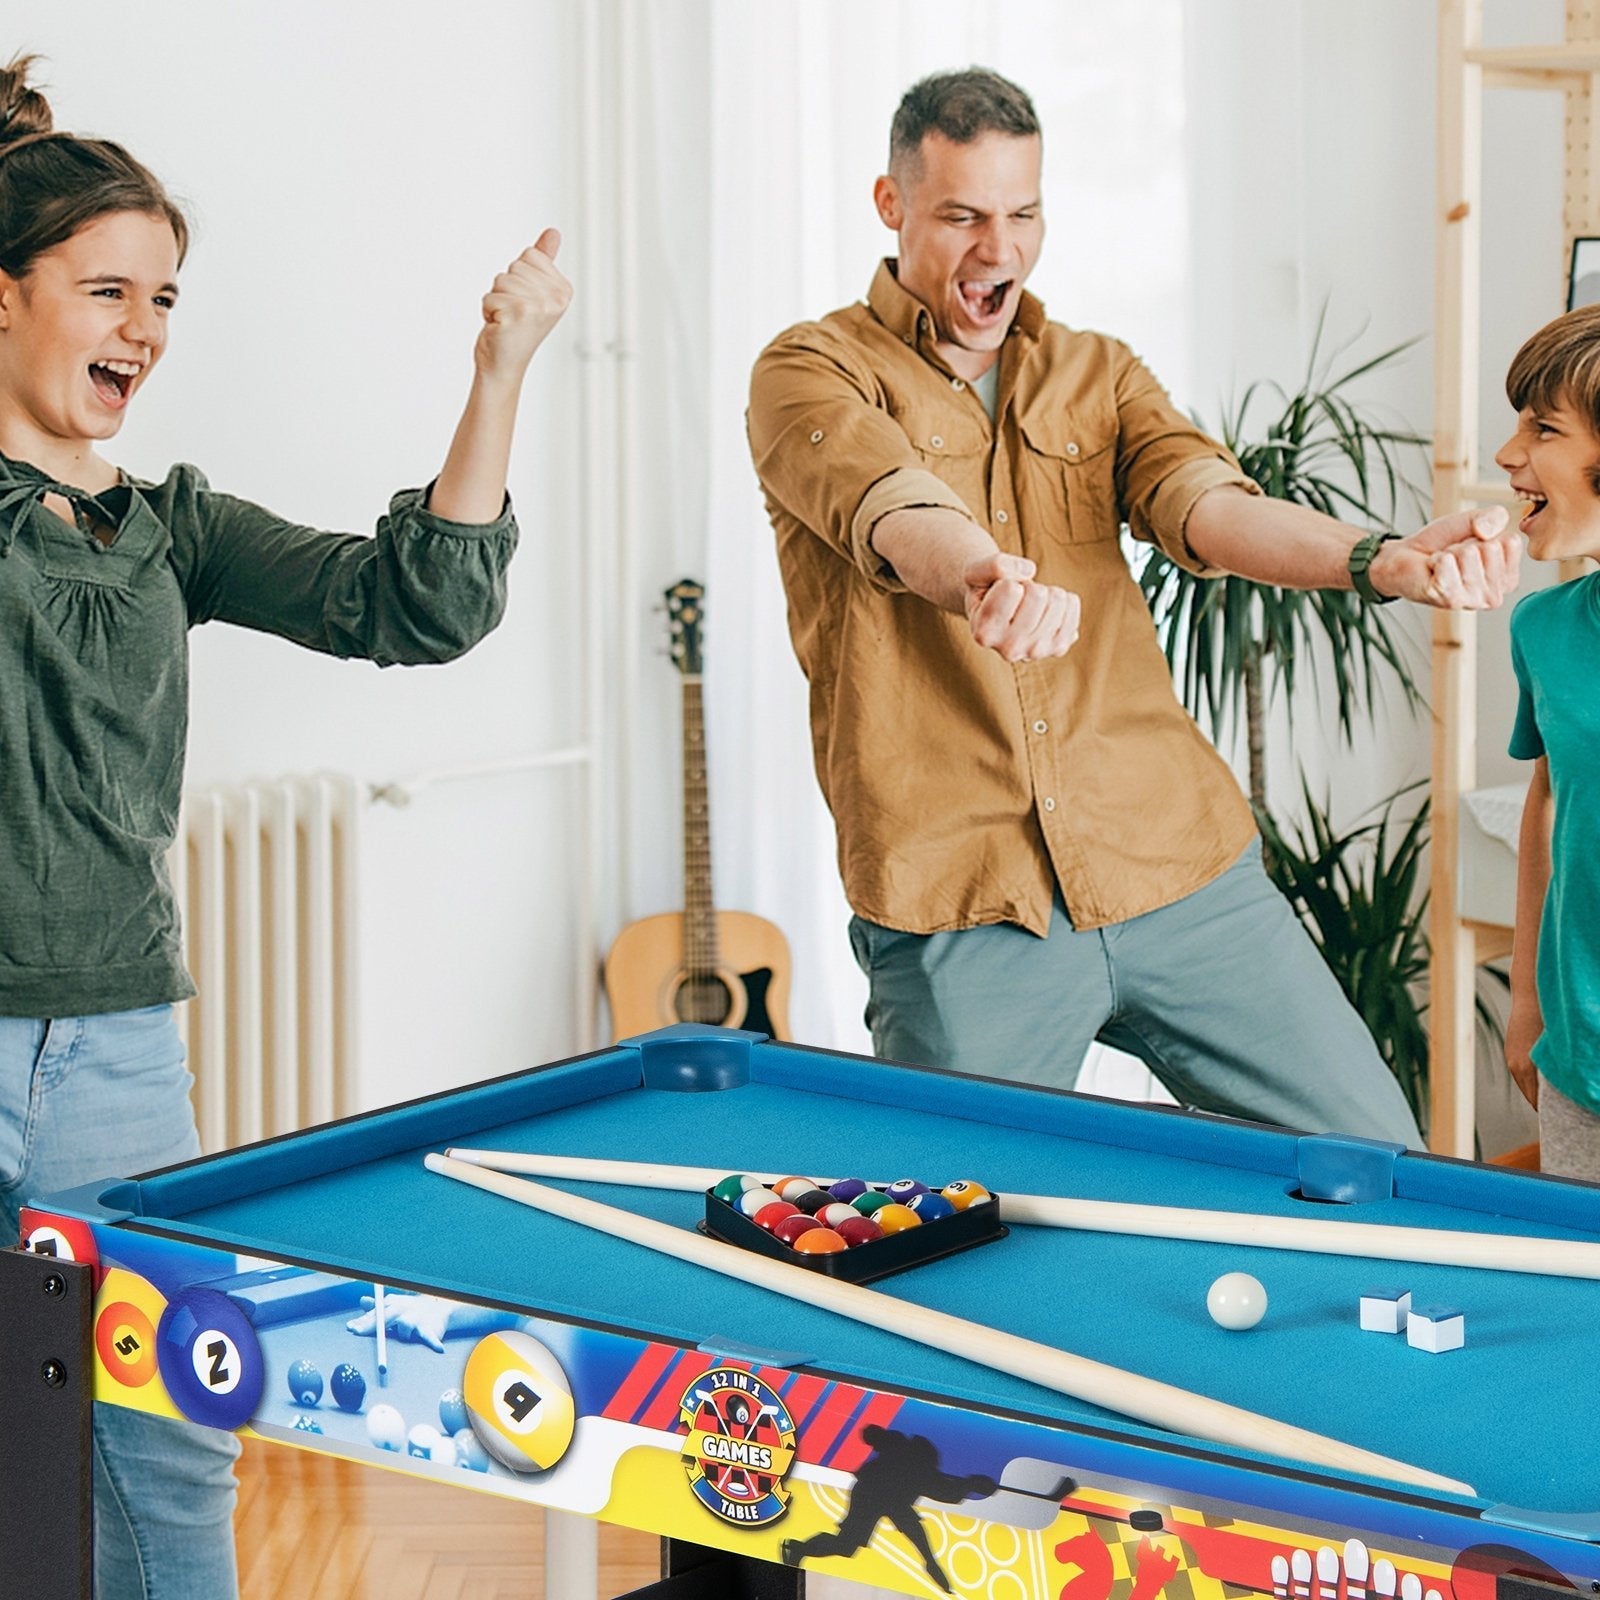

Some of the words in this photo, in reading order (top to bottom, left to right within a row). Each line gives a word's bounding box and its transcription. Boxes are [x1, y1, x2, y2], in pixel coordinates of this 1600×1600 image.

[895, 1180, 911, 1188] 4
[115, 1334, 140, 1356] 5
[207, 1339, 229, 1386] 2
[711, 1372, 729, 1389] 12
[733, 1373, 748, 1390] IN
[751, 1383, 761, 1398] 1
[503, 1381, 542, 1423] 9
[739, 1410, 746, 1422] 8
[702, 1436, 772, 1469] GAMES
[720, 1499, 759, 1521] TABLE
